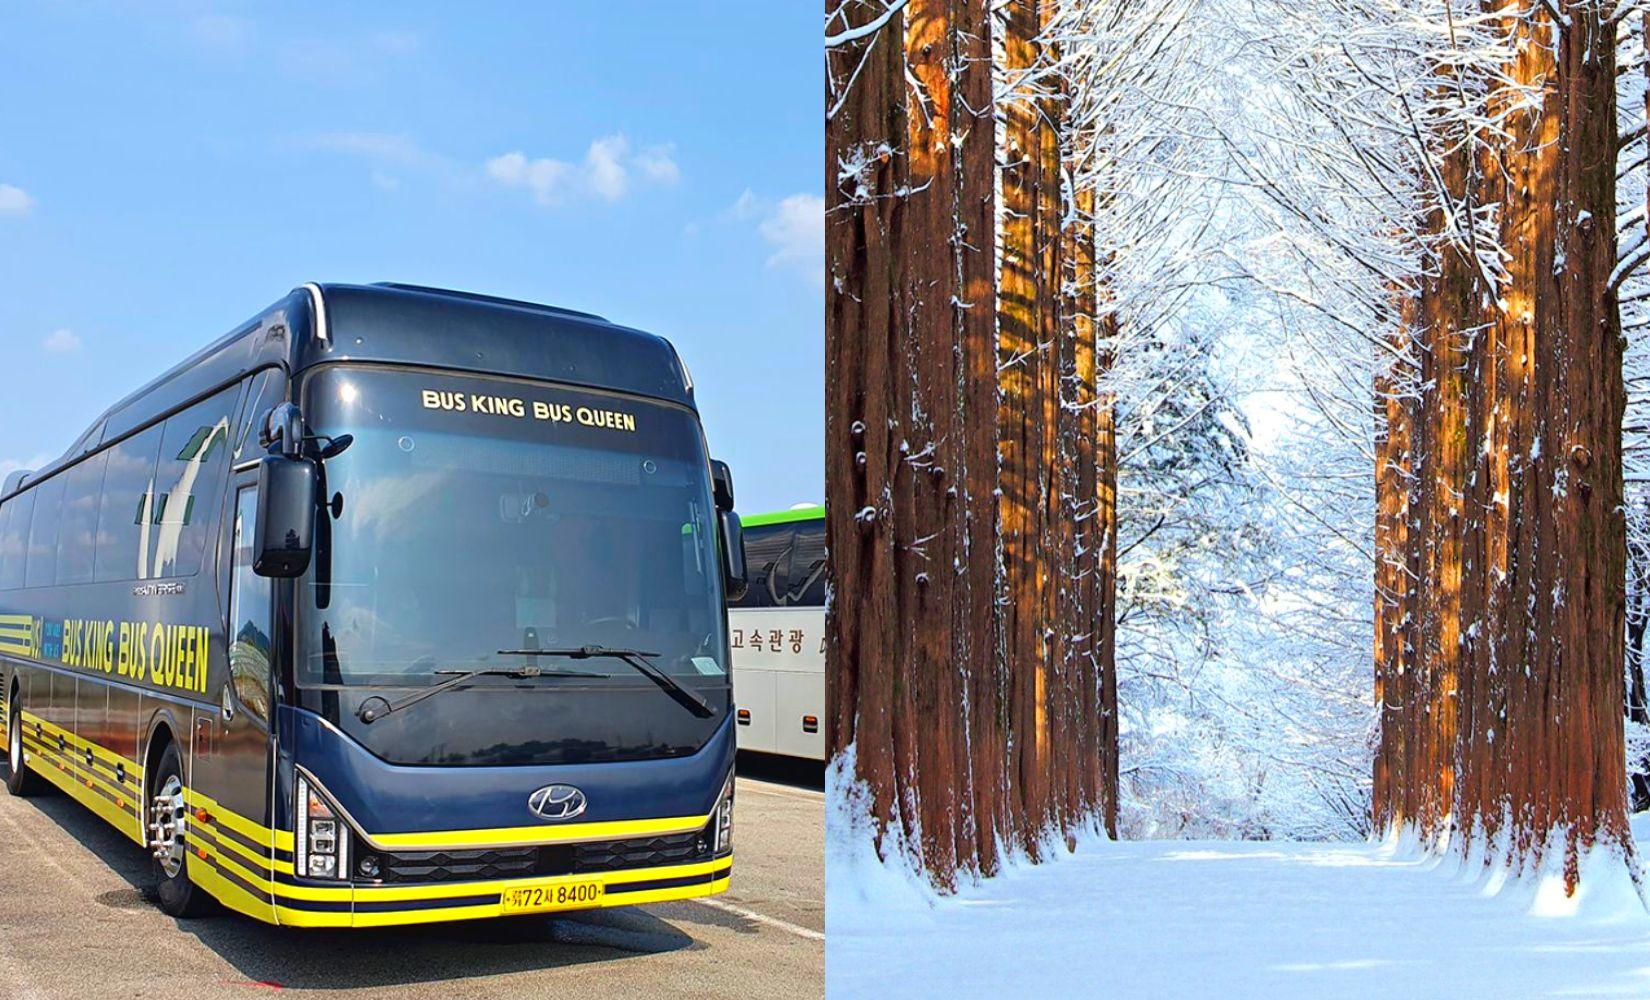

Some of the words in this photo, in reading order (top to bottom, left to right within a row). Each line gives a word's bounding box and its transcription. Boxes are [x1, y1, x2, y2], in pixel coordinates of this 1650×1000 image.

[421, 390, 466, 411] BUS
[471, 395, 525, 417] KING
[533, 402, 571, 422] BUS
[576, 408, 636, 431] QUEEN
[62, 619, 82, 666] BUS
[83, 620, 114, 673] KING
[118, 621, 147, 680] BUS
[150, 622, 209, 693] QUEEN
[557, 884, 597, 903] 8400
